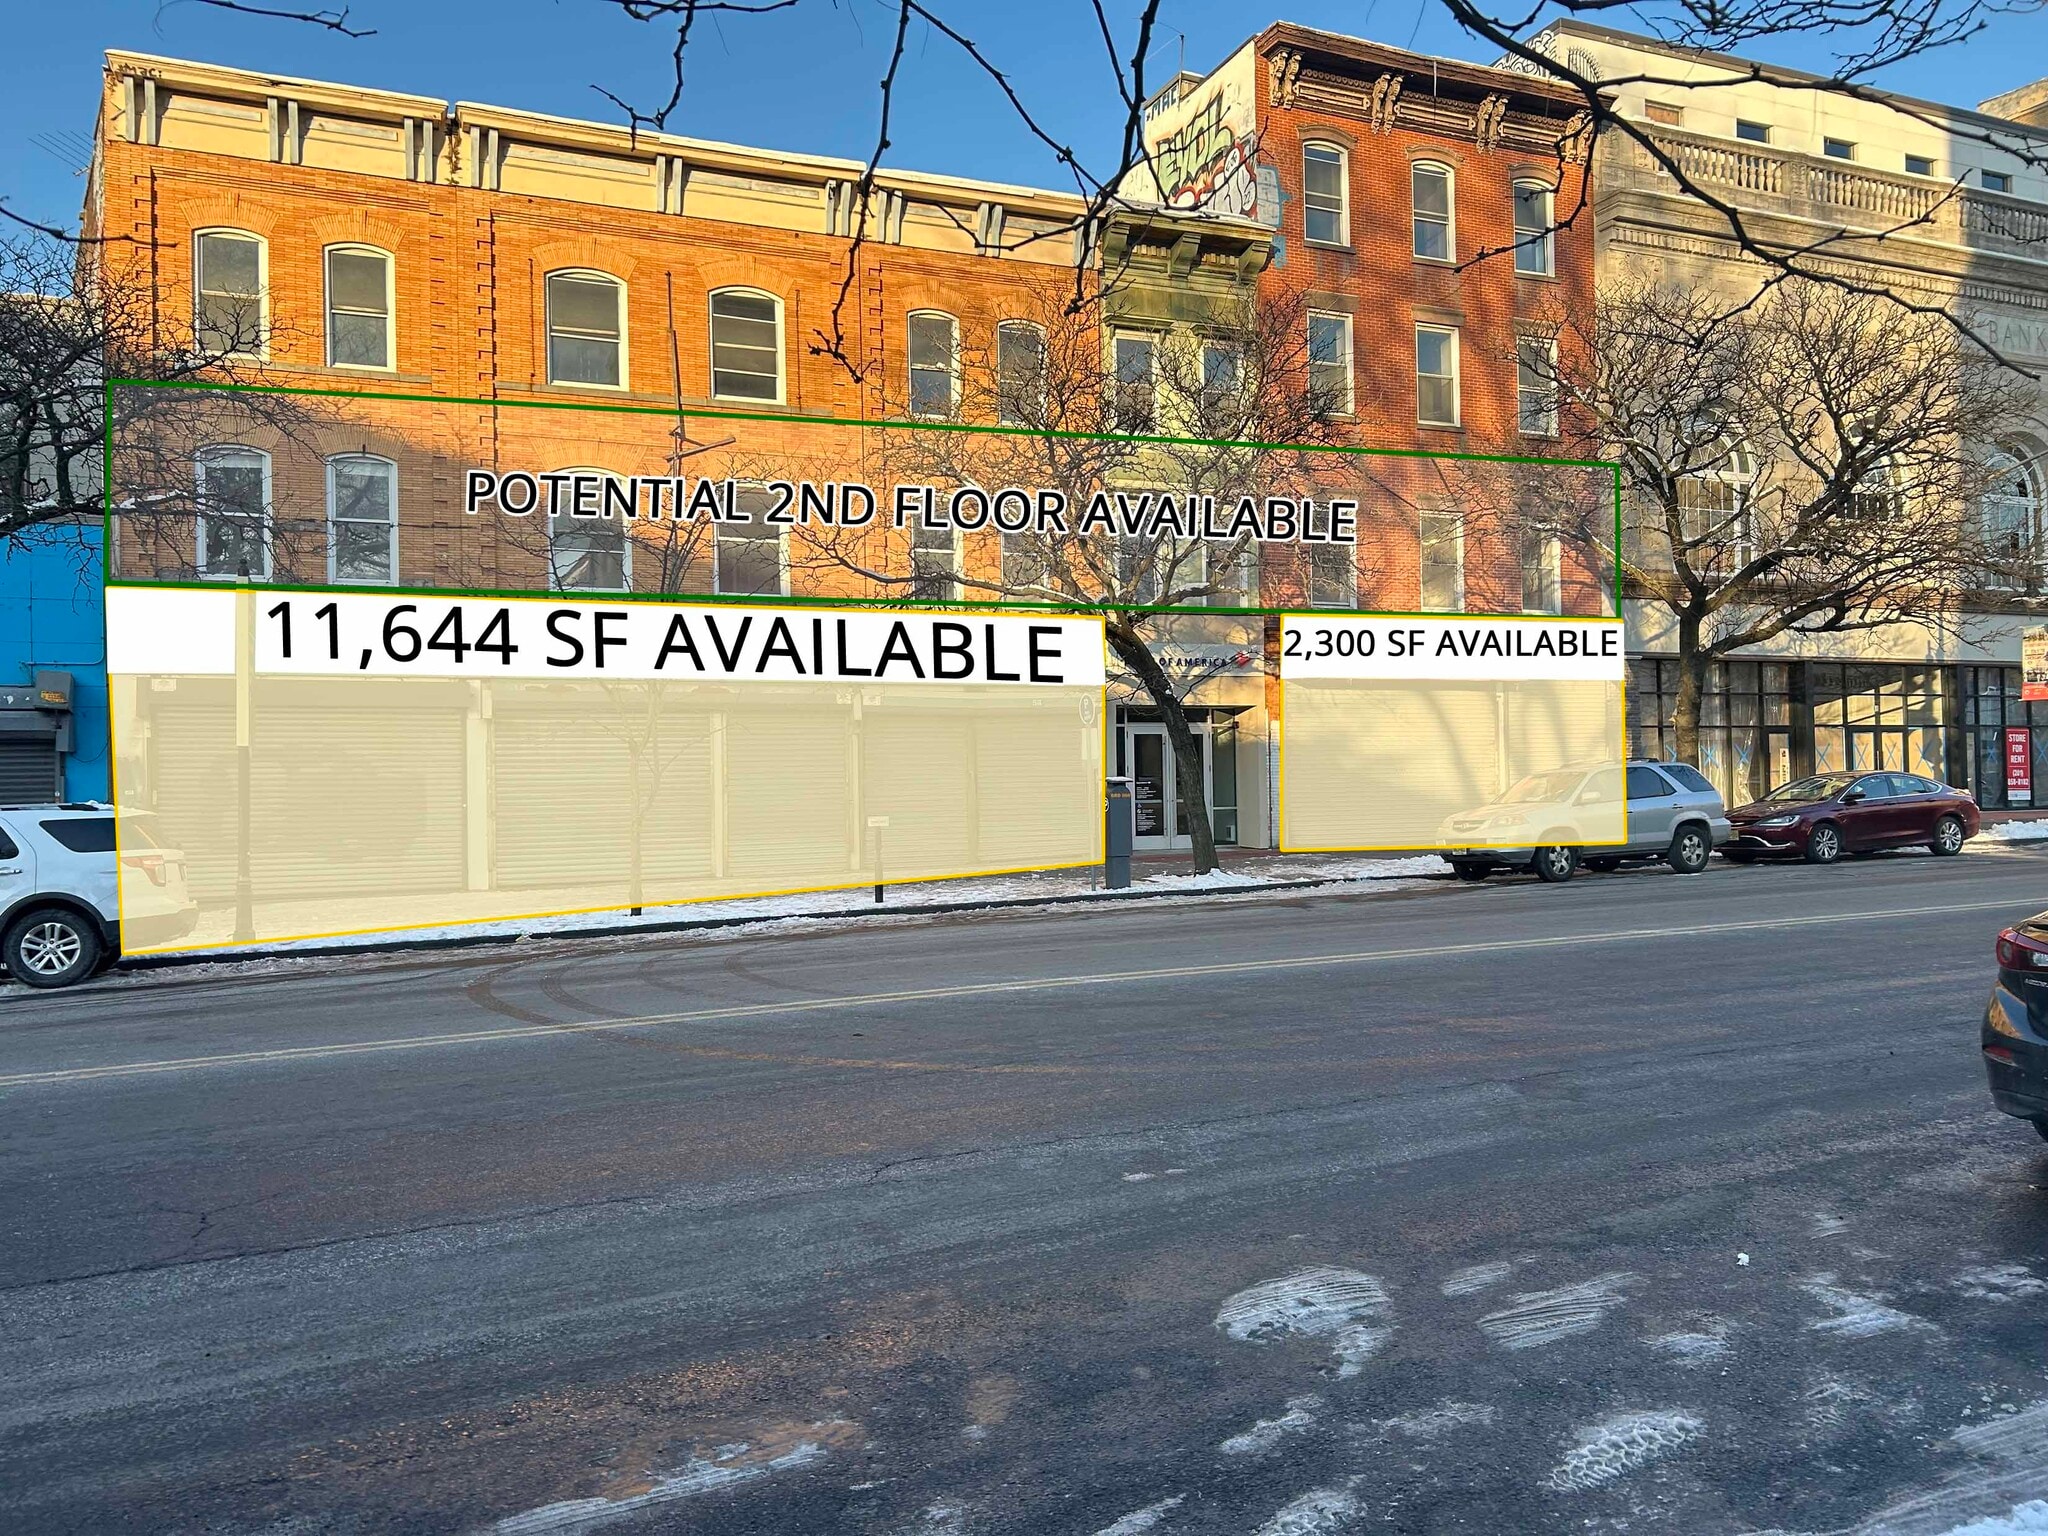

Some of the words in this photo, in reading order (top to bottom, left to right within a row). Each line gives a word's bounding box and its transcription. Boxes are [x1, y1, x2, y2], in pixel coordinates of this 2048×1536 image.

[1989, 320, 2048, 353] BANK
[1159, 657, 1173, 667] OF
[1176, 656, 1227, 668] AMERICA
[2008, 733, 2027, 743] STORE
[2012, 744, 2023, 753] FOR
[2010, 754, 2026, 764] RENT
